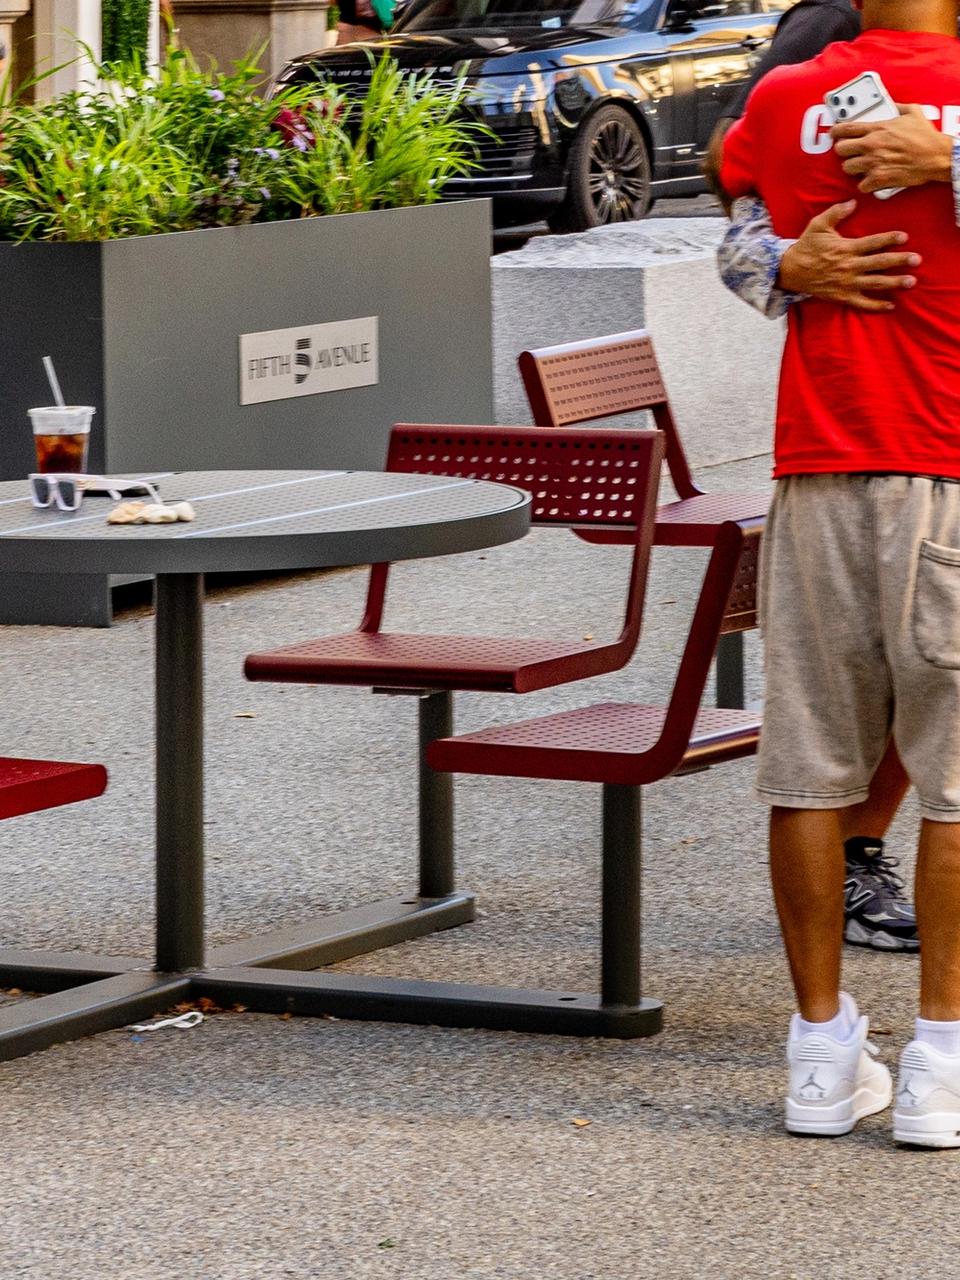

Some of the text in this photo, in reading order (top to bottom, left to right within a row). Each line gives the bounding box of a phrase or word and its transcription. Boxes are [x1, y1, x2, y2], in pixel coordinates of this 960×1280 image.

[248, 338, 370, 384] FIFTH 5 AVENUE
